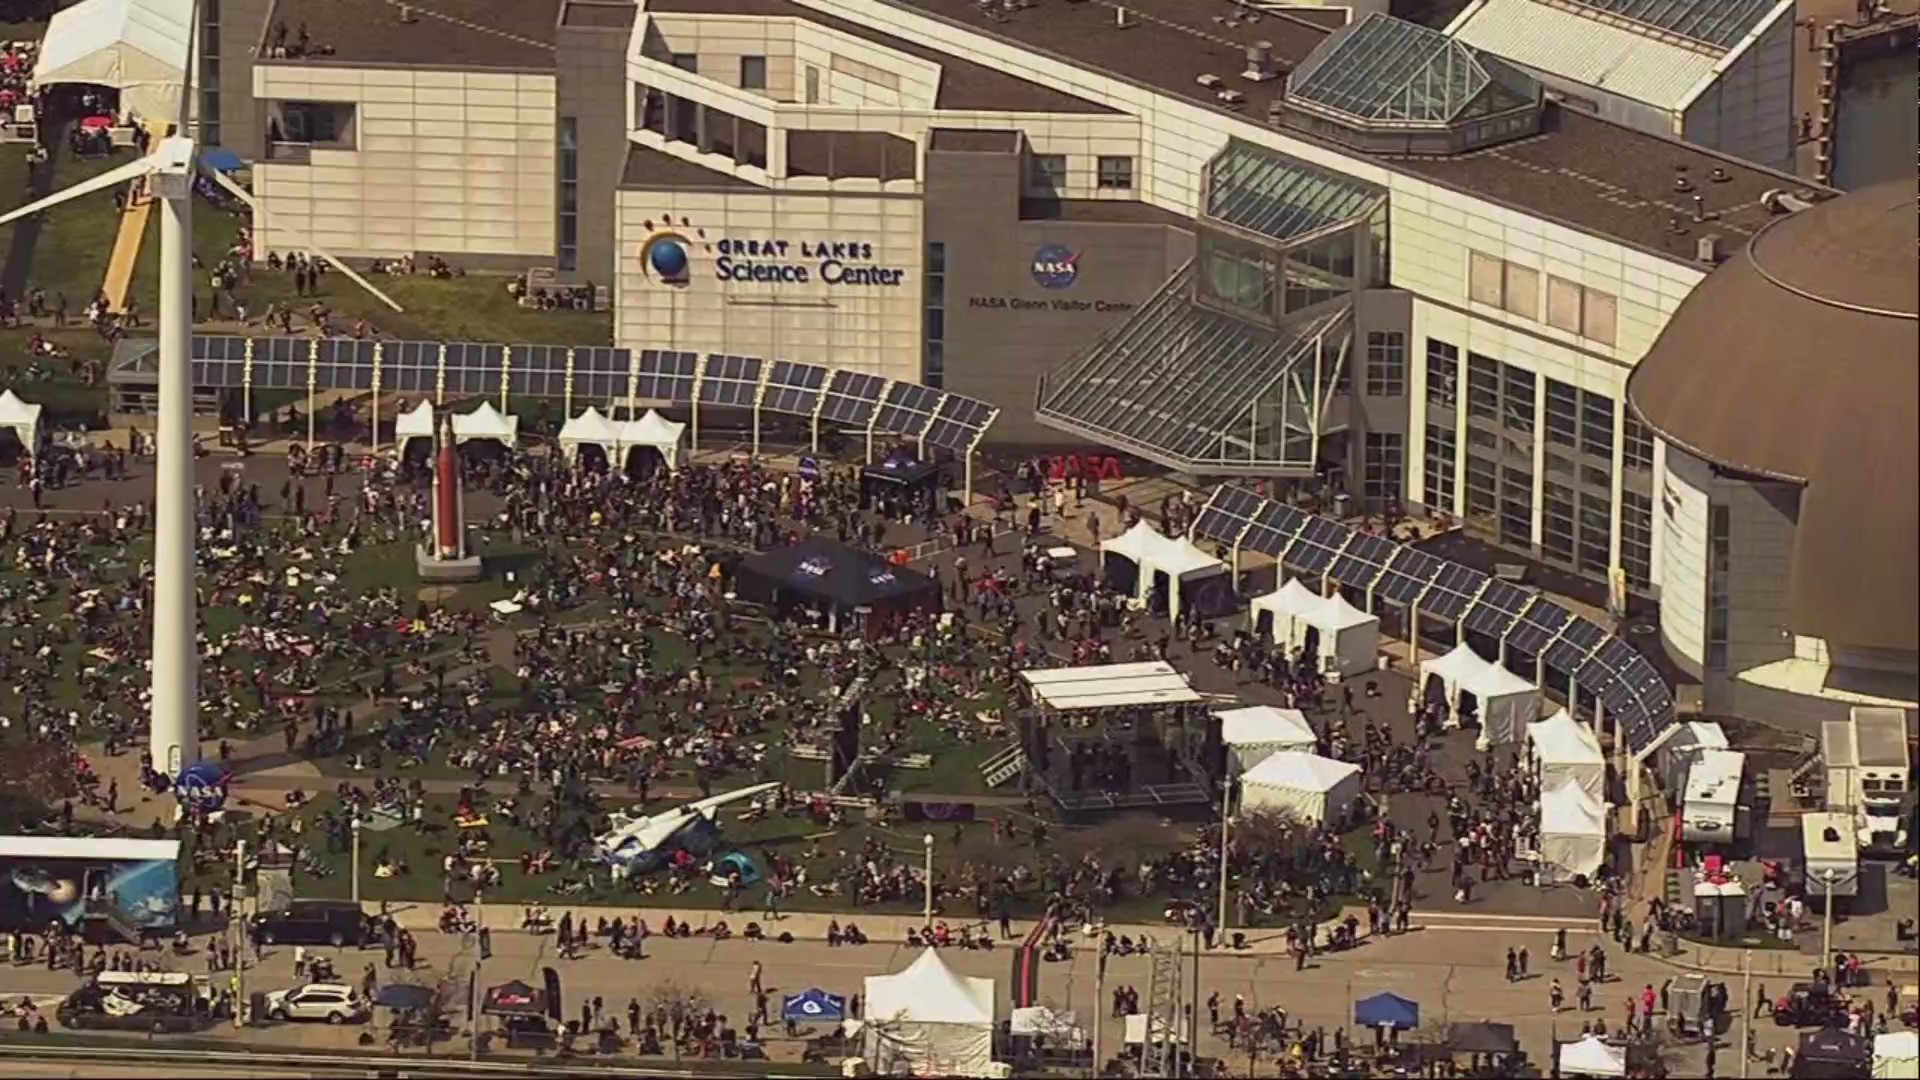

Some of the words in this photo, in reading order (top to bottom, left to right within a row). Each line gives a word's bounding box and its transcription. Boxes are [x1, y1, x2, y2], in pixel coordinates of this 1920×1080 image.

[717, 239, 789, 257] GREAT
[801, 241, 873, 259] LAKES
[716, 256, 809, 283] Science
[820, 260, 904, 286] Center
[1033, 262, 1076, 274] NASA
[969, 297, 1007, 309] NASA
[1010, 298, 1049, 310] Glenn
[1051, 300, 1092, 311] Visitor
